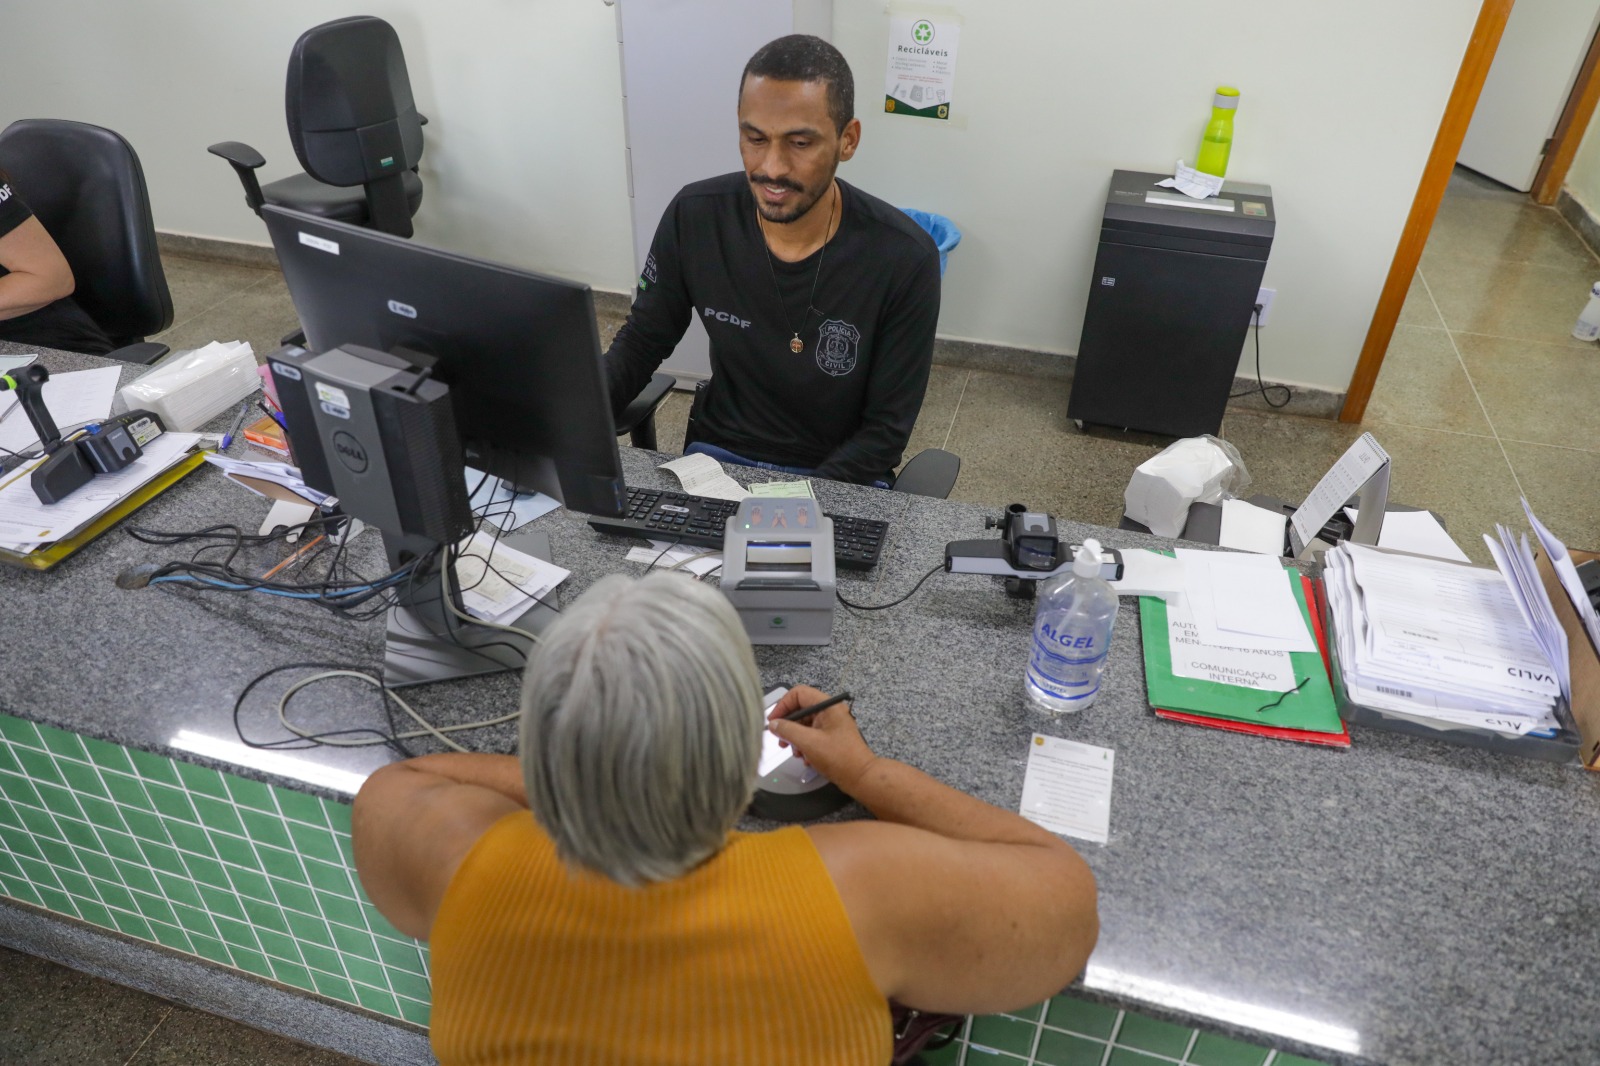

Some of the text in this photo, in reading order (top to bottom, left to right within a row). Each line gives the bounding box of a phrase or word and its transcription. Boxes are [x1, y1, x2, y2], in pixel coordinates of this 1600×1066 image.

[897, 45, 948, 57] Recicláveis
[0, 183, 12, 204] DF
[704, 307, 751, 329] PCDF
[825, 360, 845, 369] CIVIL
[337, 442, 364, 461] DELL
[1041, 623, 1094, 648] ALGEL
[1191, 662, 1277, 681] COMUNICAÇÃO
[1209, 673, 1259, 686] INTERNA
